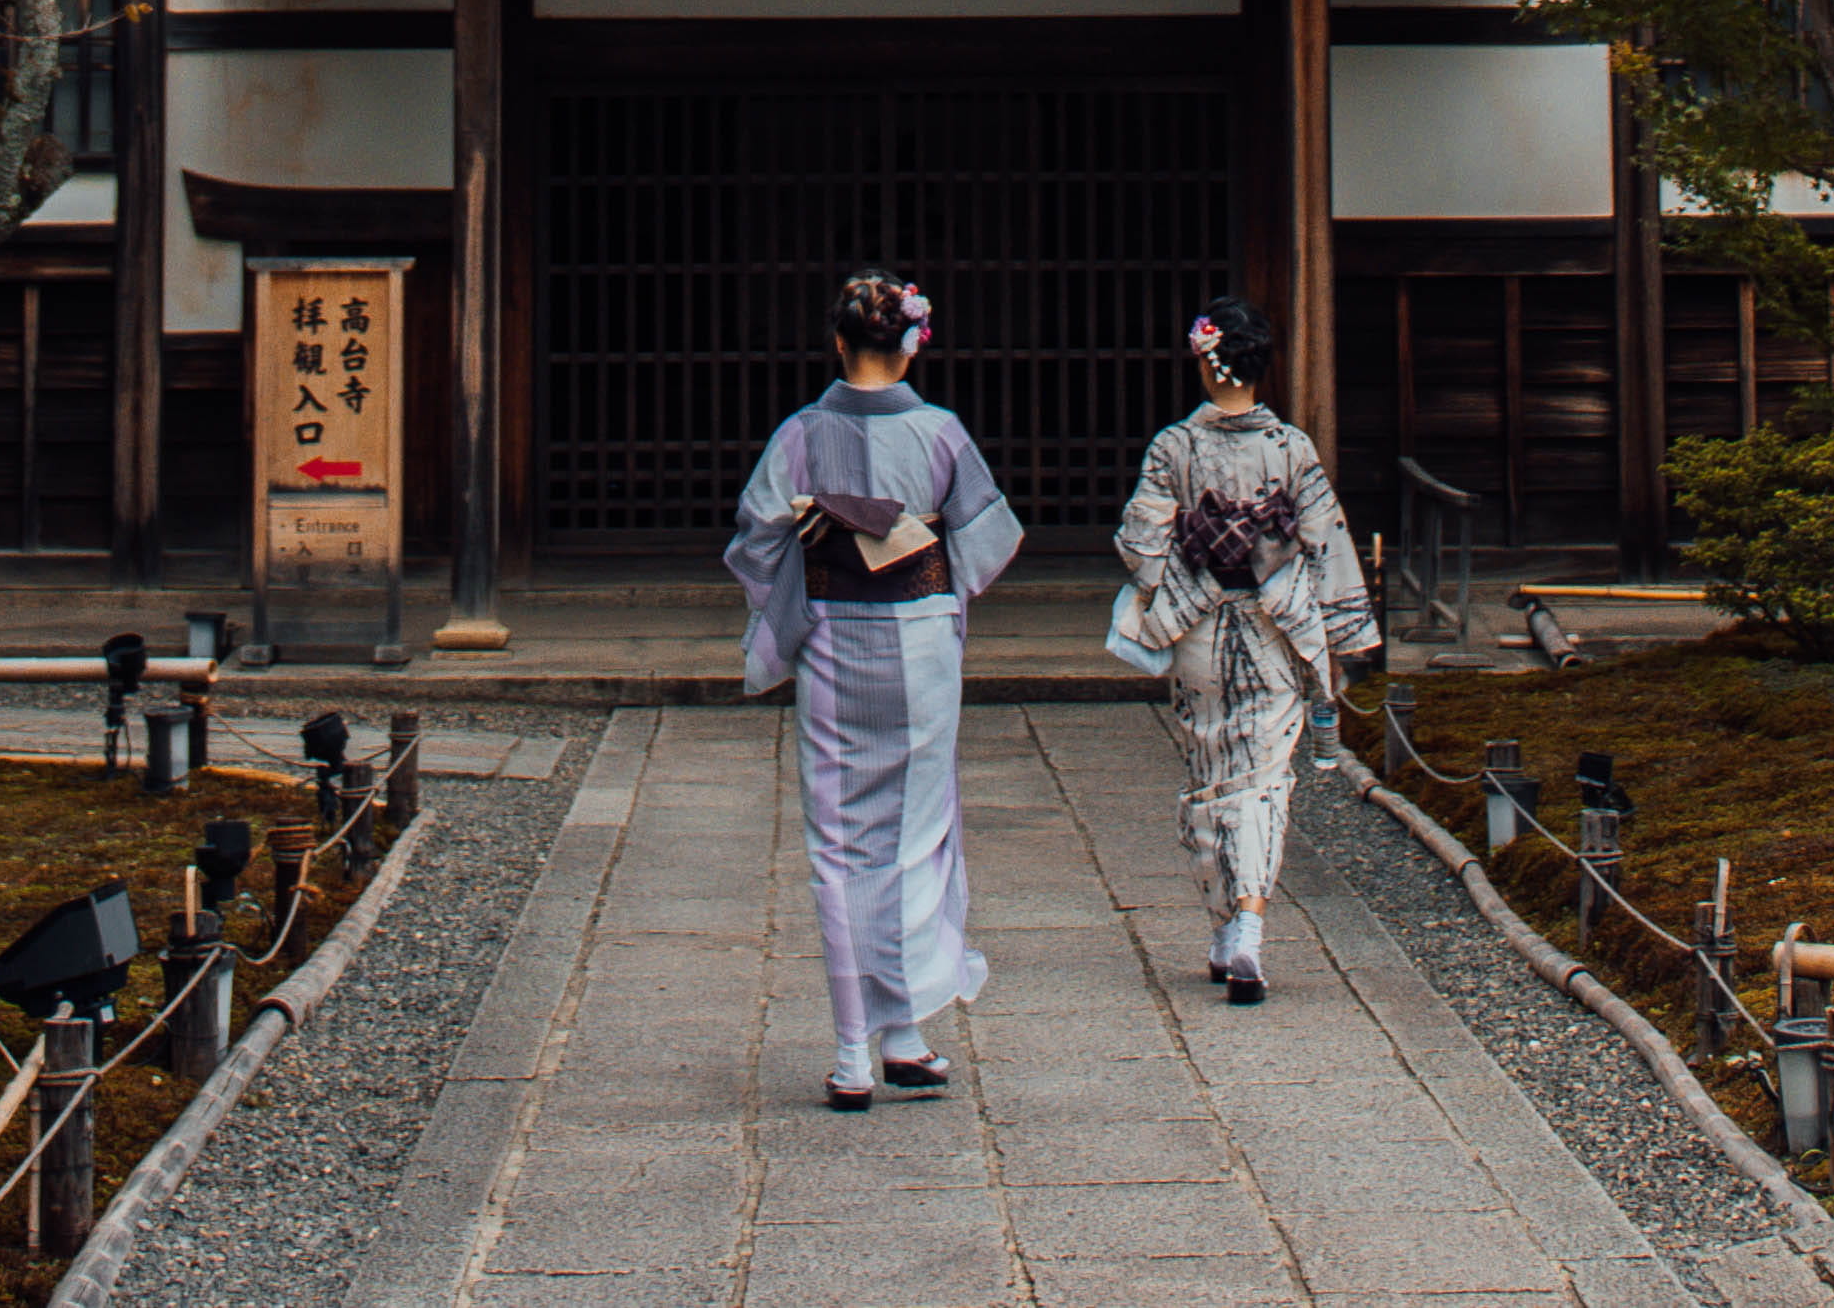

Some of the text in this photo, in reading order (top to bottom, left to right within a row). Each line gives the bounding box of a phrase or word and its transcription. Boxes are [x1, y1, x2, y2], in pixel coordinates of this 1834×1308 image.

[293, 297, 328, 445] 拝観入口
[337, 297, 370, 414] 高台寺
[295, 517, 360, 534] Entrance
